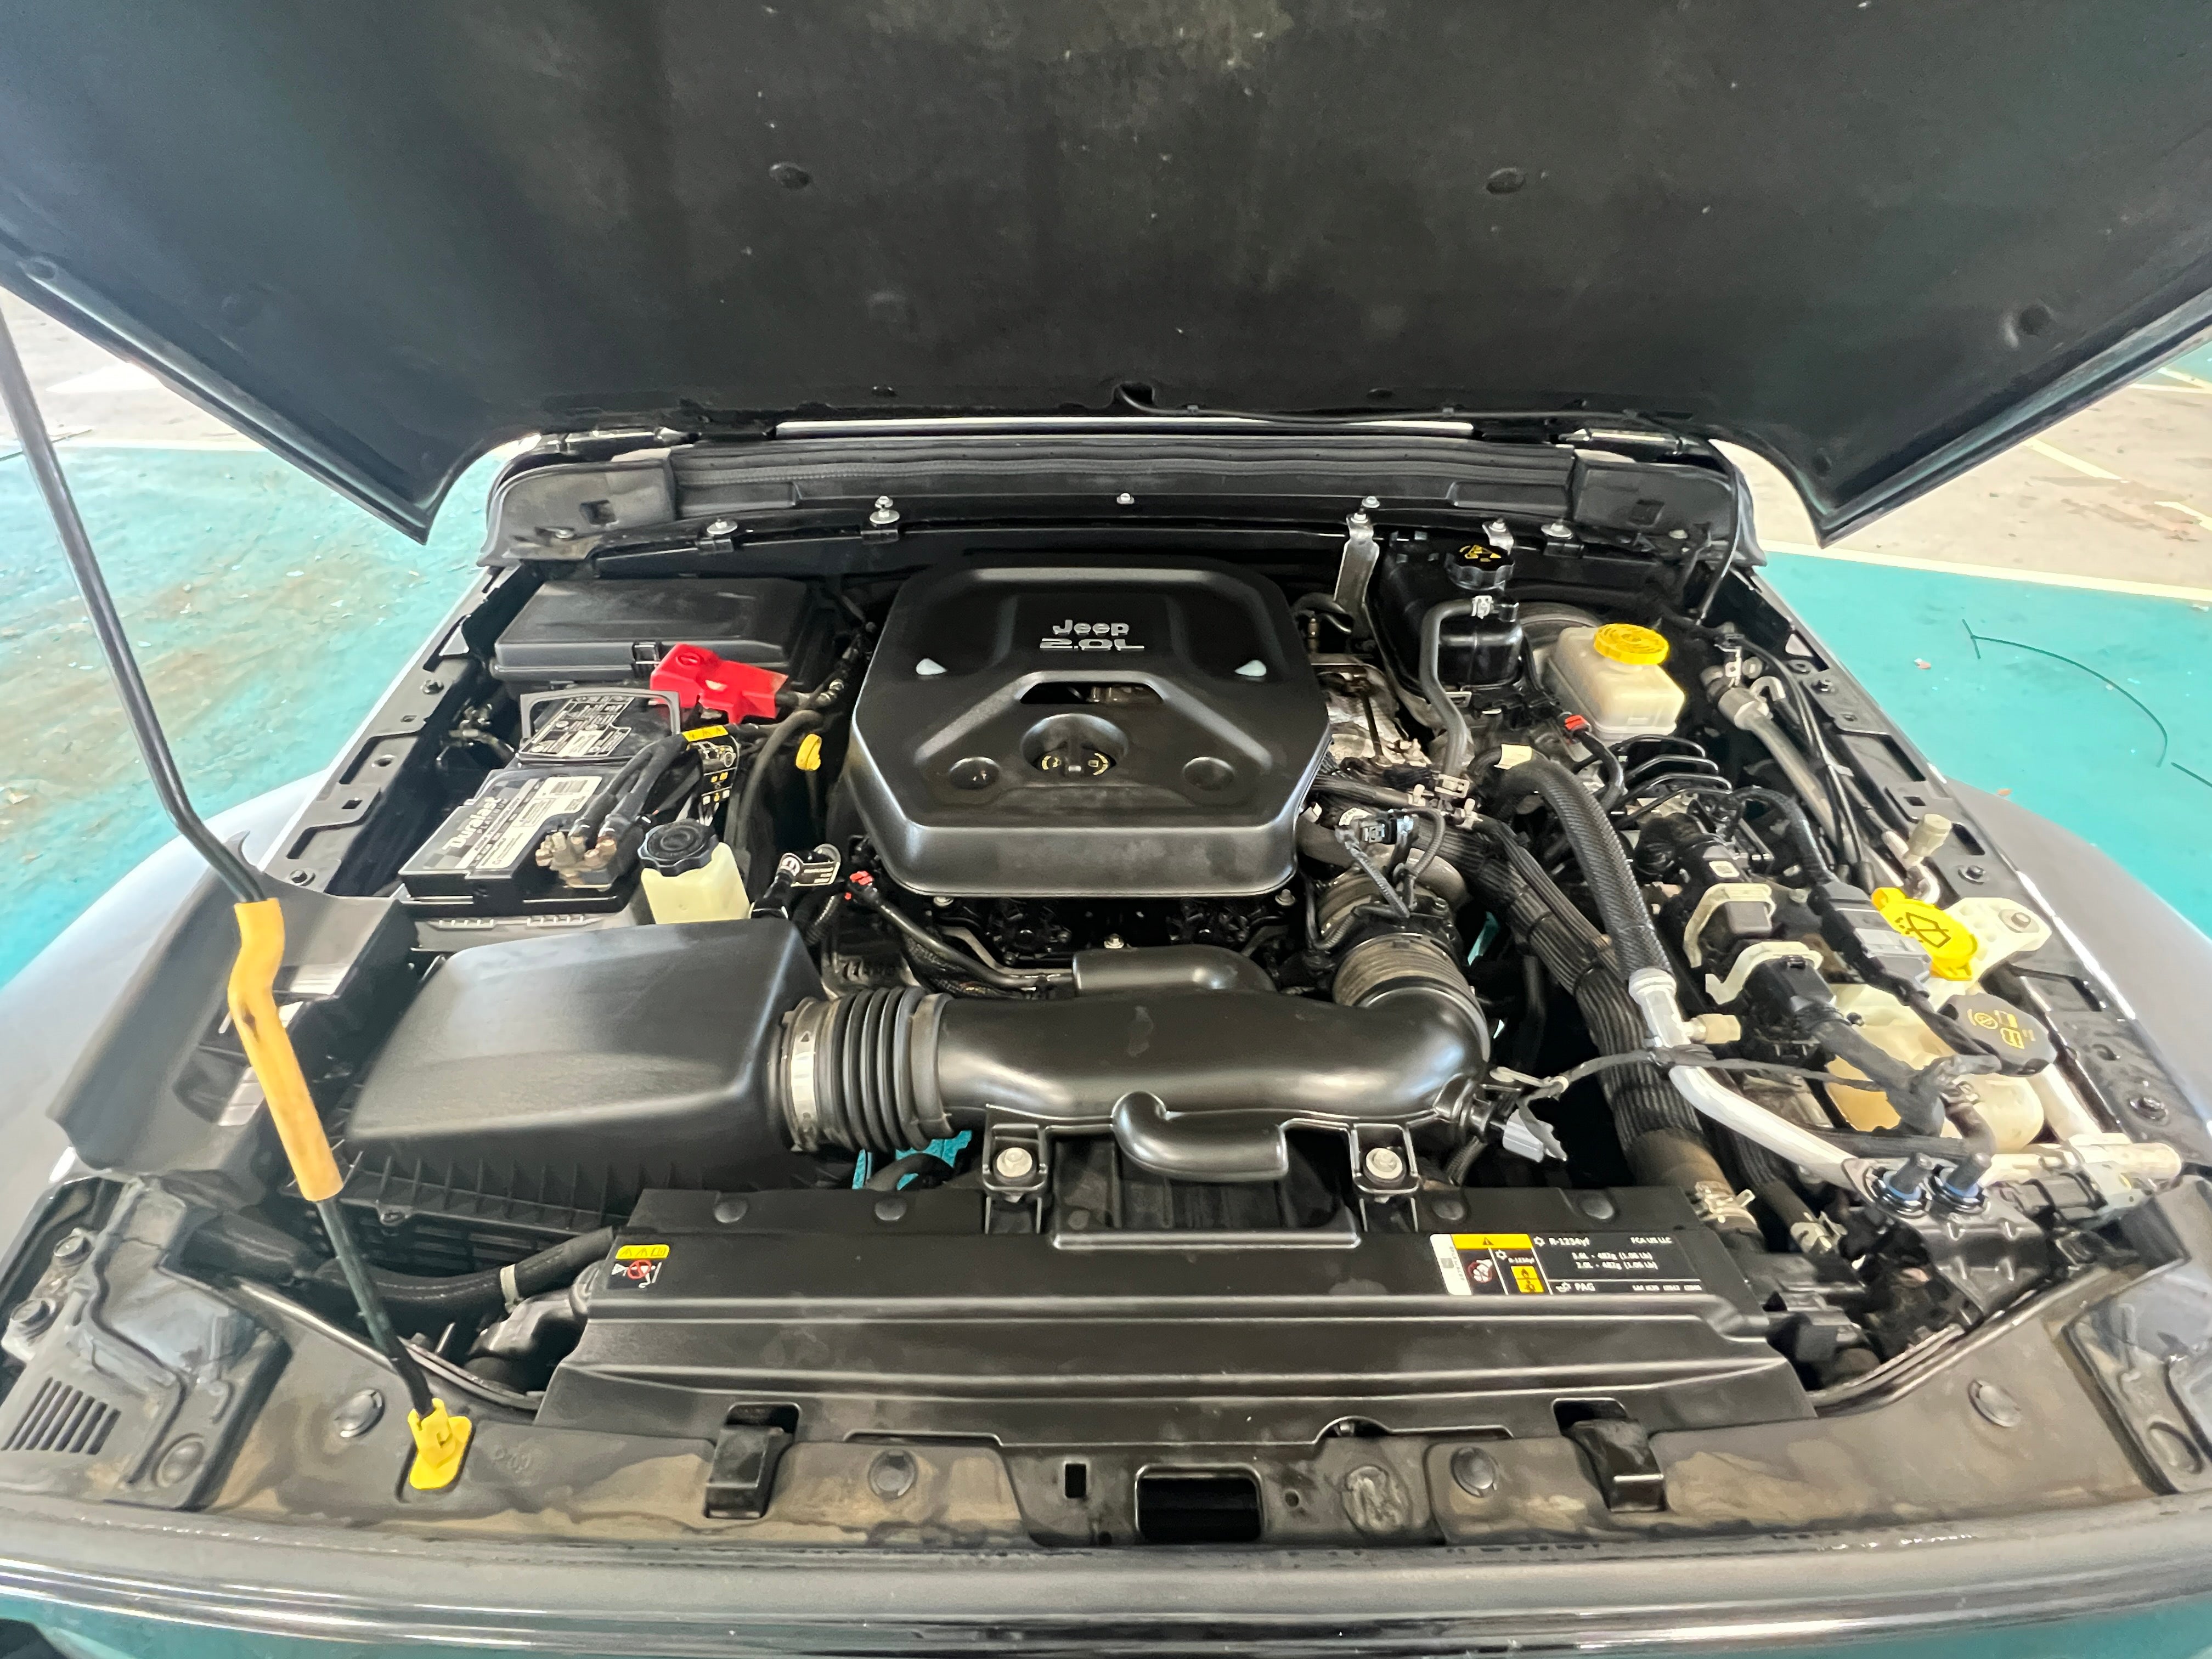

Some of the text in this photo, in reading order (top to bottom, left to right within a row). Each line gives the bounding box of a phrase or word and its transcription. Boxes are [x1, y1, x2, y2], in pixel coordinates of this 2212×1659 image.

[1052, 619, 1130, 636] Jeep
[1040, 637, 1145, 651] 2.0L
[442, 797, 502, 850] Duralast
[1549, 1237, 1589, 1246] R-1234yf
[1575, 1283, 1596, 1291] PAG
